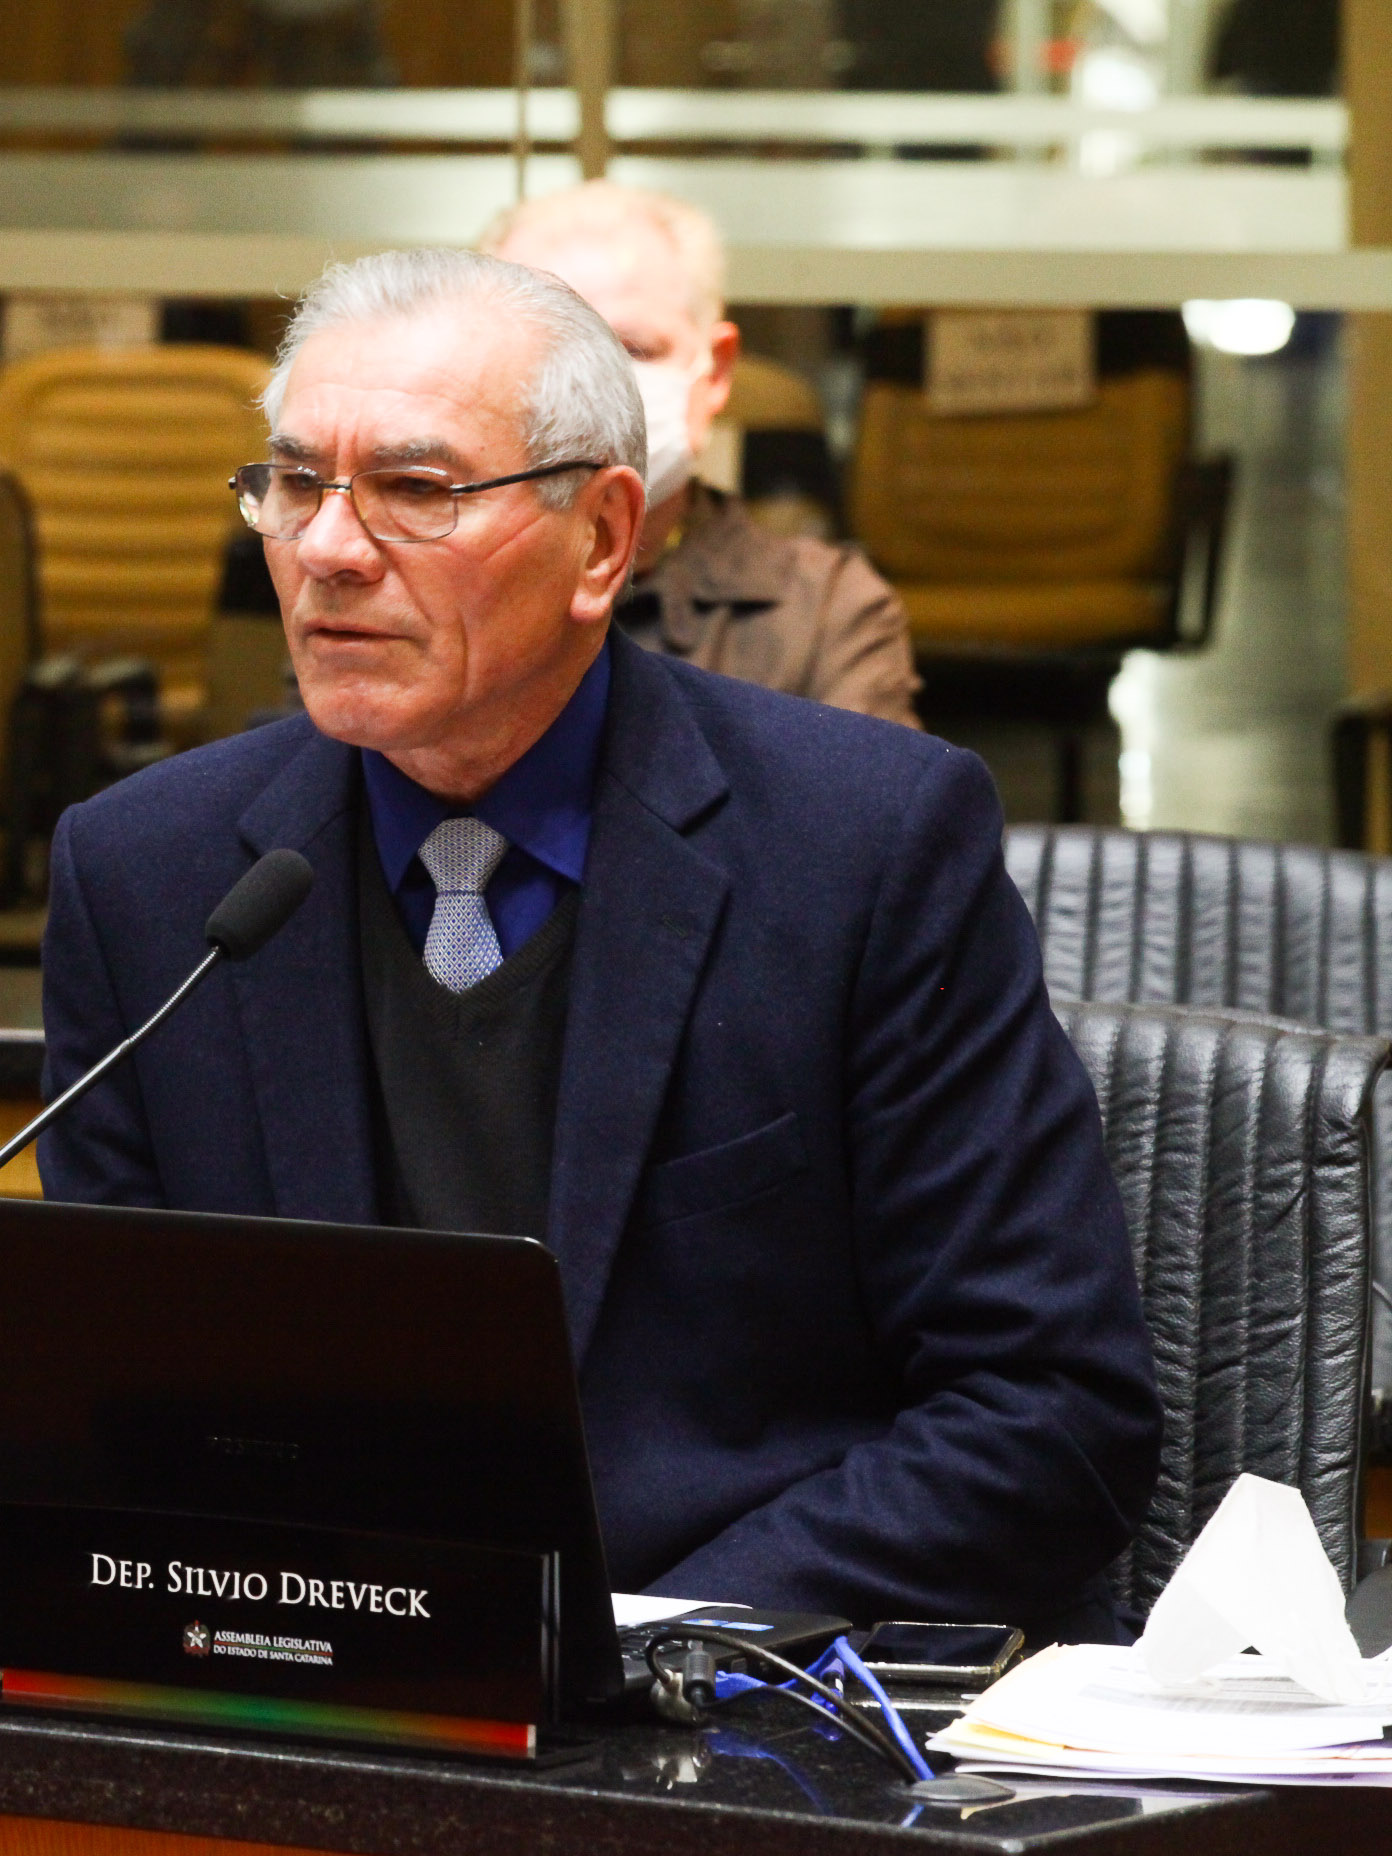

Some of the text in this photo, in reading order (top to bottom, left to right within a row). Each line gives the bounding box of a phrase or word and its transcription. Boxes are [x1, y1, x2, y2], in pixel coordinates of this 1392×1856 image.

[167, 1561, 268, 1601] SILVIO
[278, 1572, 431, 1618] DREVECK
[214, 1630, 333, 1653] ASSEMBLEIA LEGISLATIVA
[213, 1645, 333, 1666] DO ESTADO DE SANTA CATARINA
